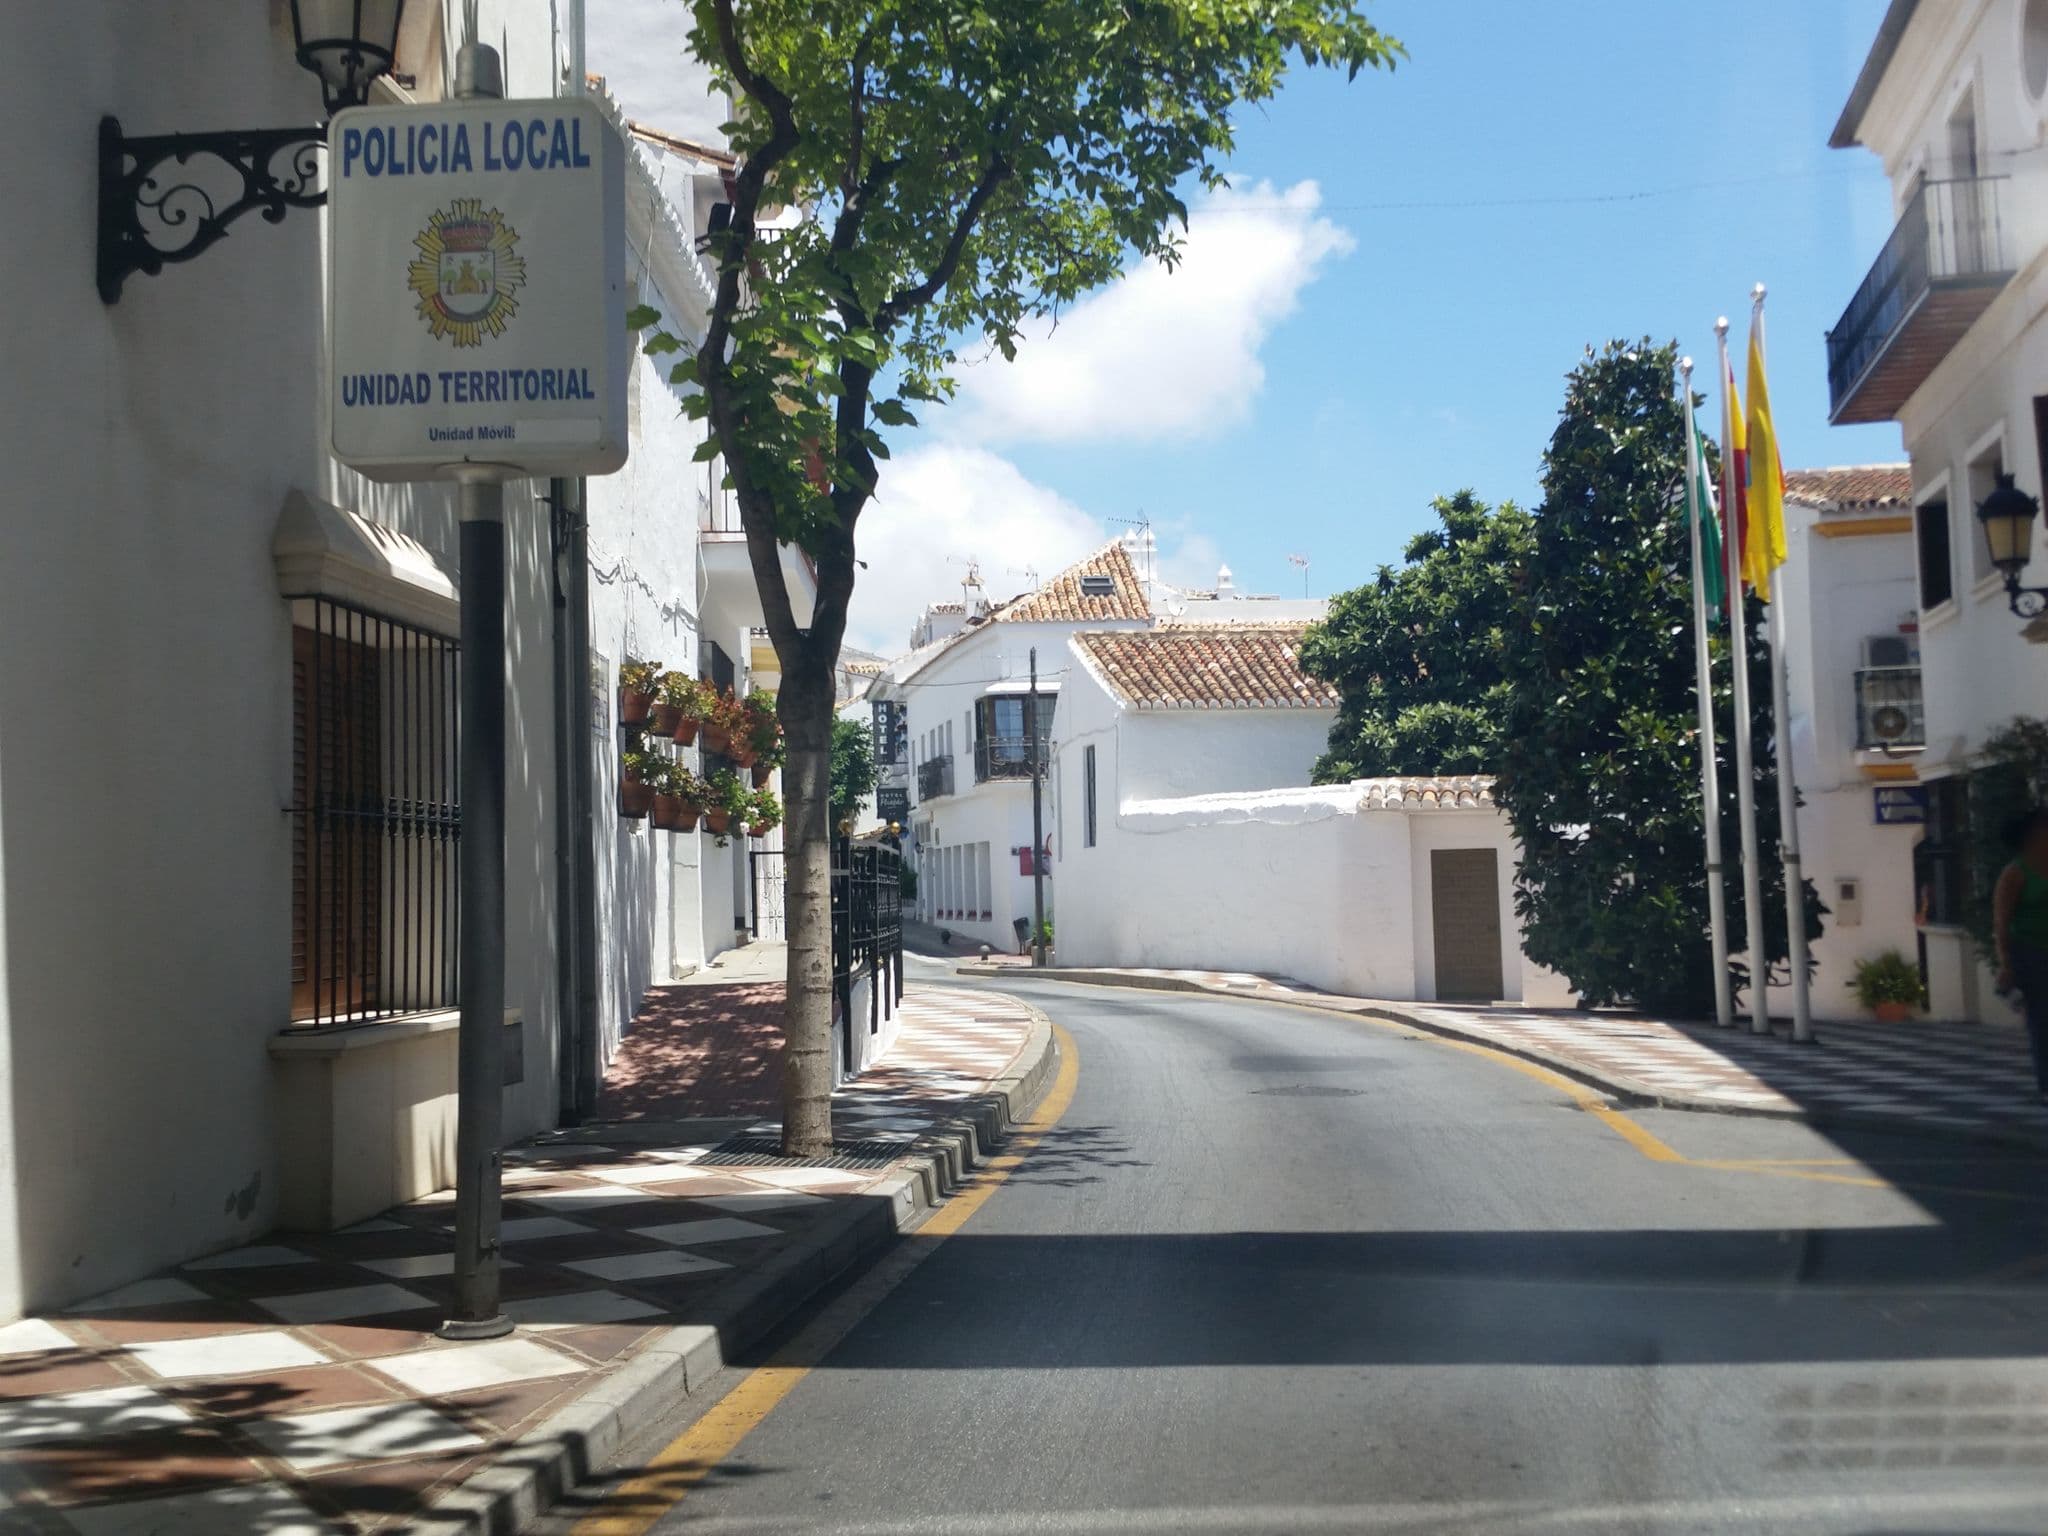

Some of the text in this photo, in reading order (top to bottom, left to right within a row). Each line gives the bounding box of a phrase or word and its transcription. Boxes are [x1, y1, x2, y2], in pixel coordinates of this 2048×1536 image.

[343, 117, 591, 178] POLICIA LOCAL
[343, 368, 595, 407] UNIDAD TERRITORIAL
[428, 426, 474, 442] Unidad
[878, 704, 888, 754] HOTEL
